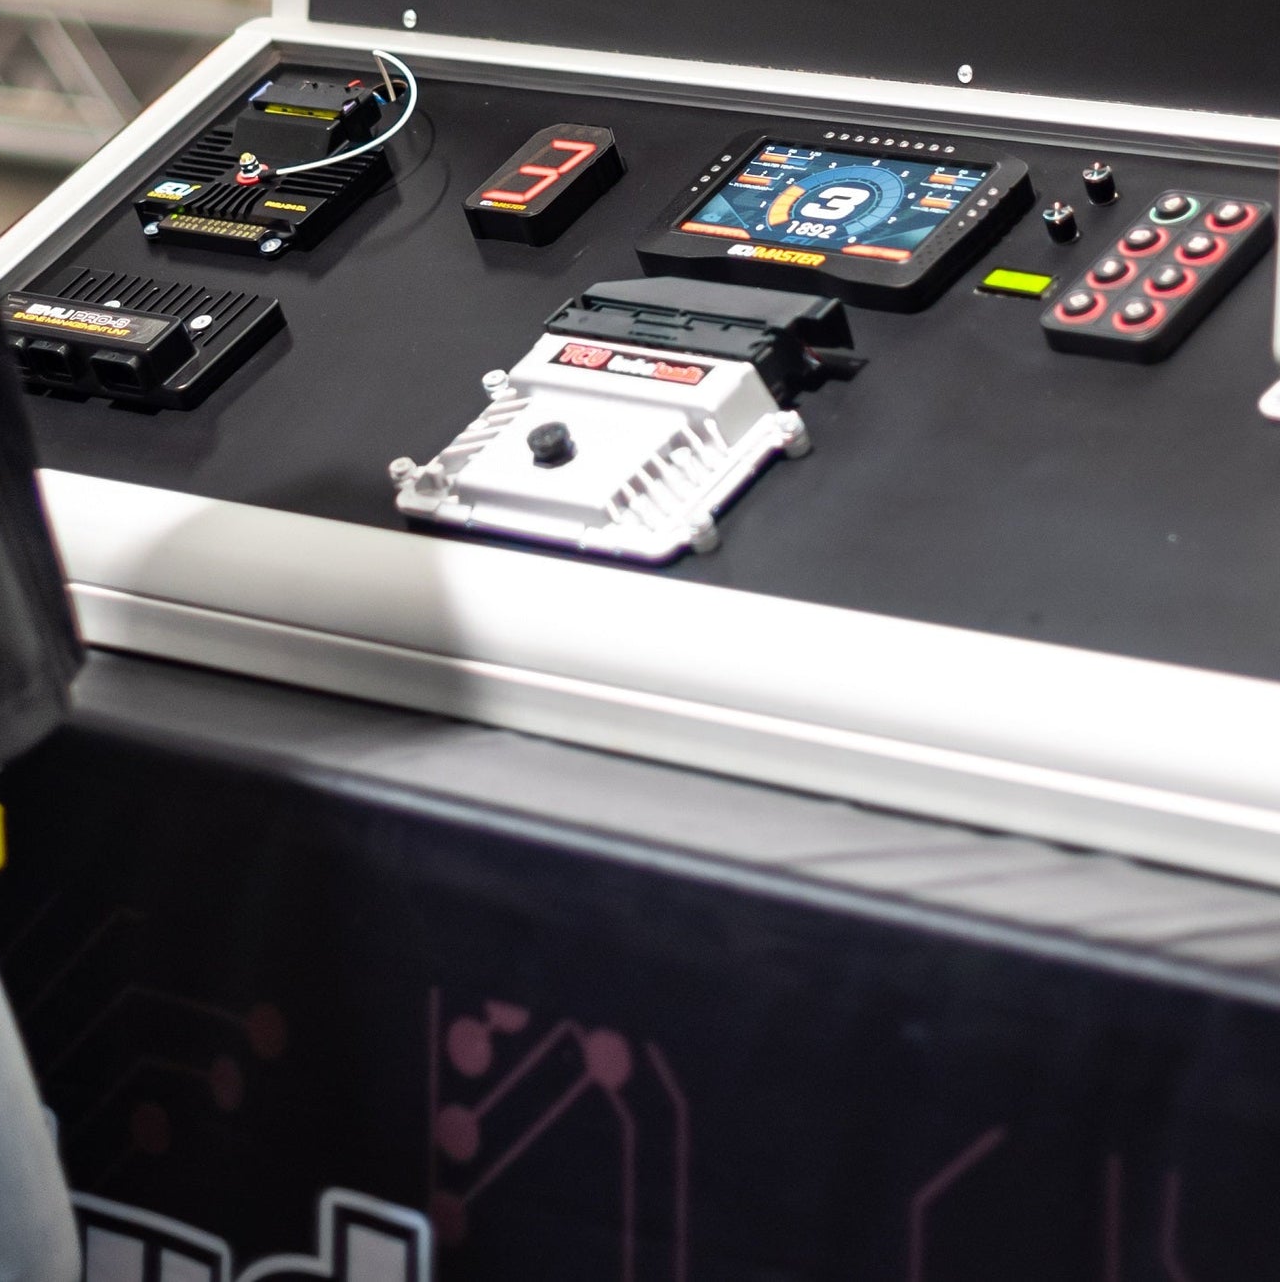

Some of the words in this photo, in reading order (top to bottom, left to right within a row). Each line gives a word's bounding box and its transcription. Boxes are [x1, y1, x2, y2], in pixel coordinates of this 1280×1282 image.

[480, 138, 597, 203] 3
[801, 186, 870, 220] 3
[786, 220, 837, 239] 1892
[726, 244, 826, 267] ECUMASTER
[26, 303, 75, 320] EMU
[559, 344, 613, 369] TCU
